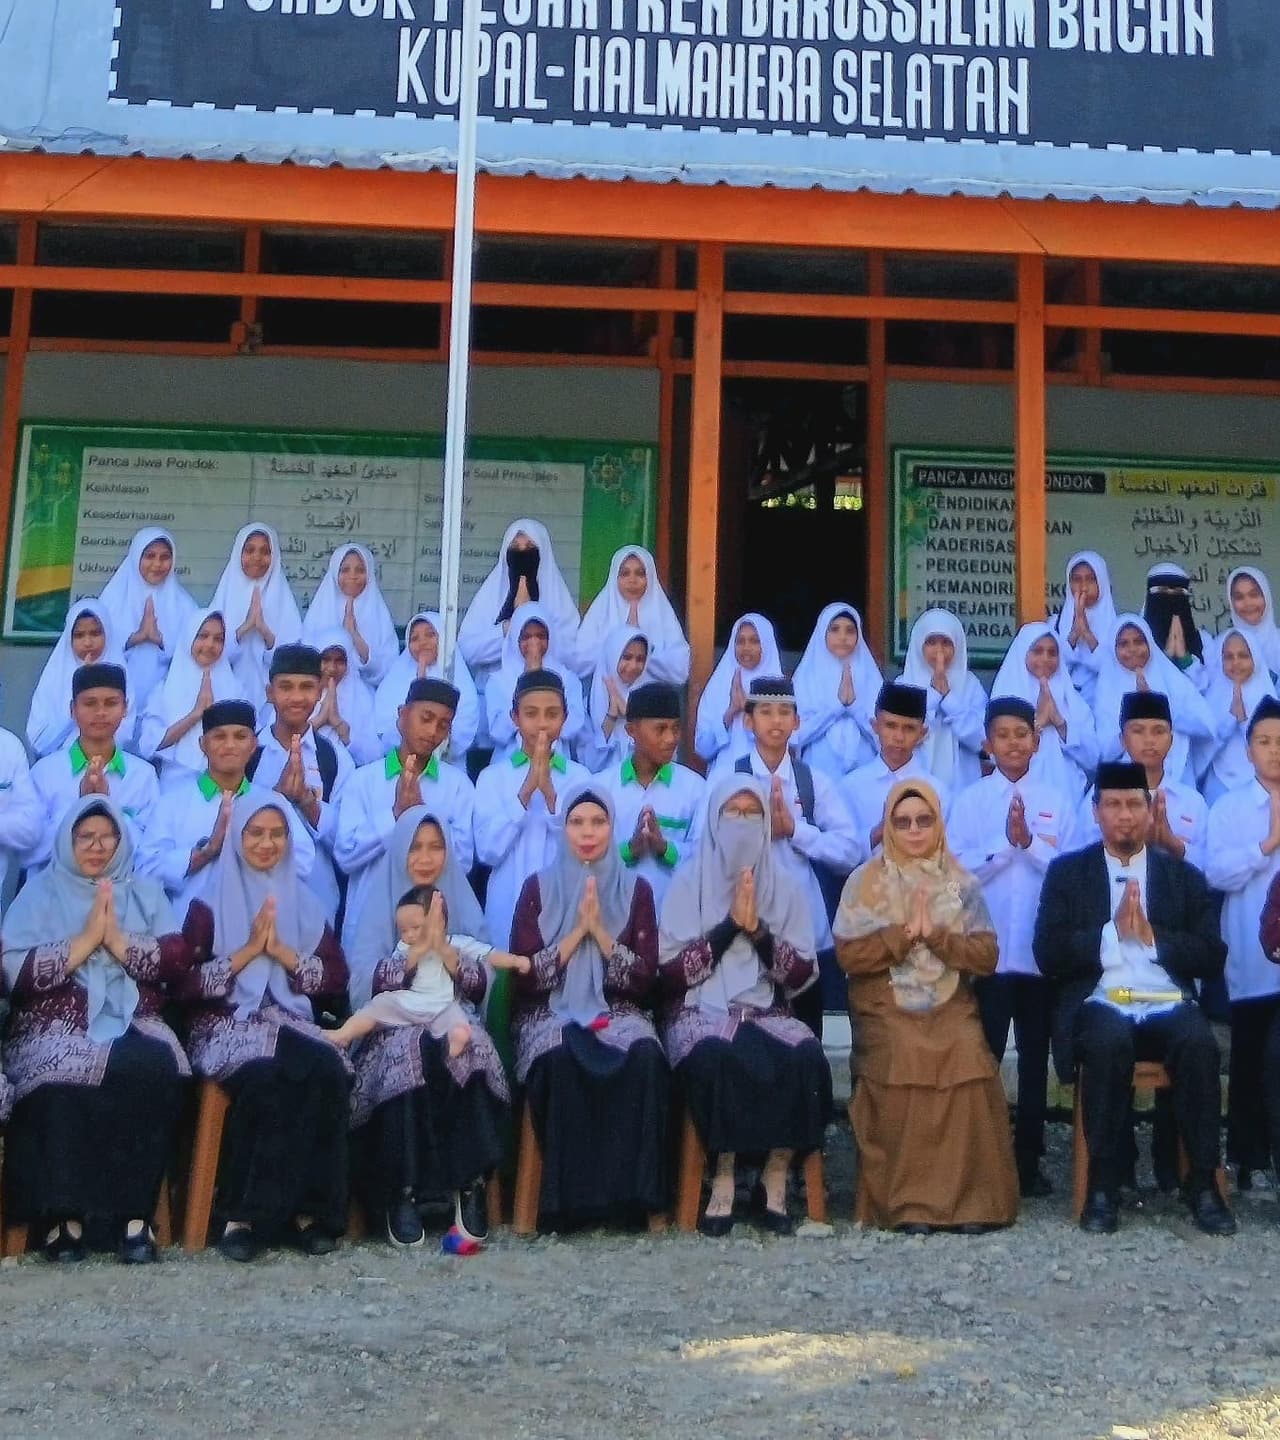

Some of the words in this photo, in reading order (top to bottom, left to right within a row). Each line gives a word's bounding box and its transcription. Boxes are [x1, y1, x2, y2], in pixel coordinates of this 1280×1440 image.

[832, 48, 1031, 137] SELATAN
[88, 455, 129, 468] Panca
[133, 456, 163, 469] Jiwa
[473, 467, 499, 481] Soul
[502, 469, 560, 483] Principles
[919, 470, 967, 485] PANCA
[969, 471, 1015, 486] JANGK
[1044, 474, 1093, 489] ONDOK
[85, 482, 150, 495] Keikhlasan
[83, 509, 176, 522] Kesederhanaan
[929, 516, 962, 532] DAN
[80, 535, 133, 547] Berdikar
[926, 537, 1016, 553] KADERISAS
